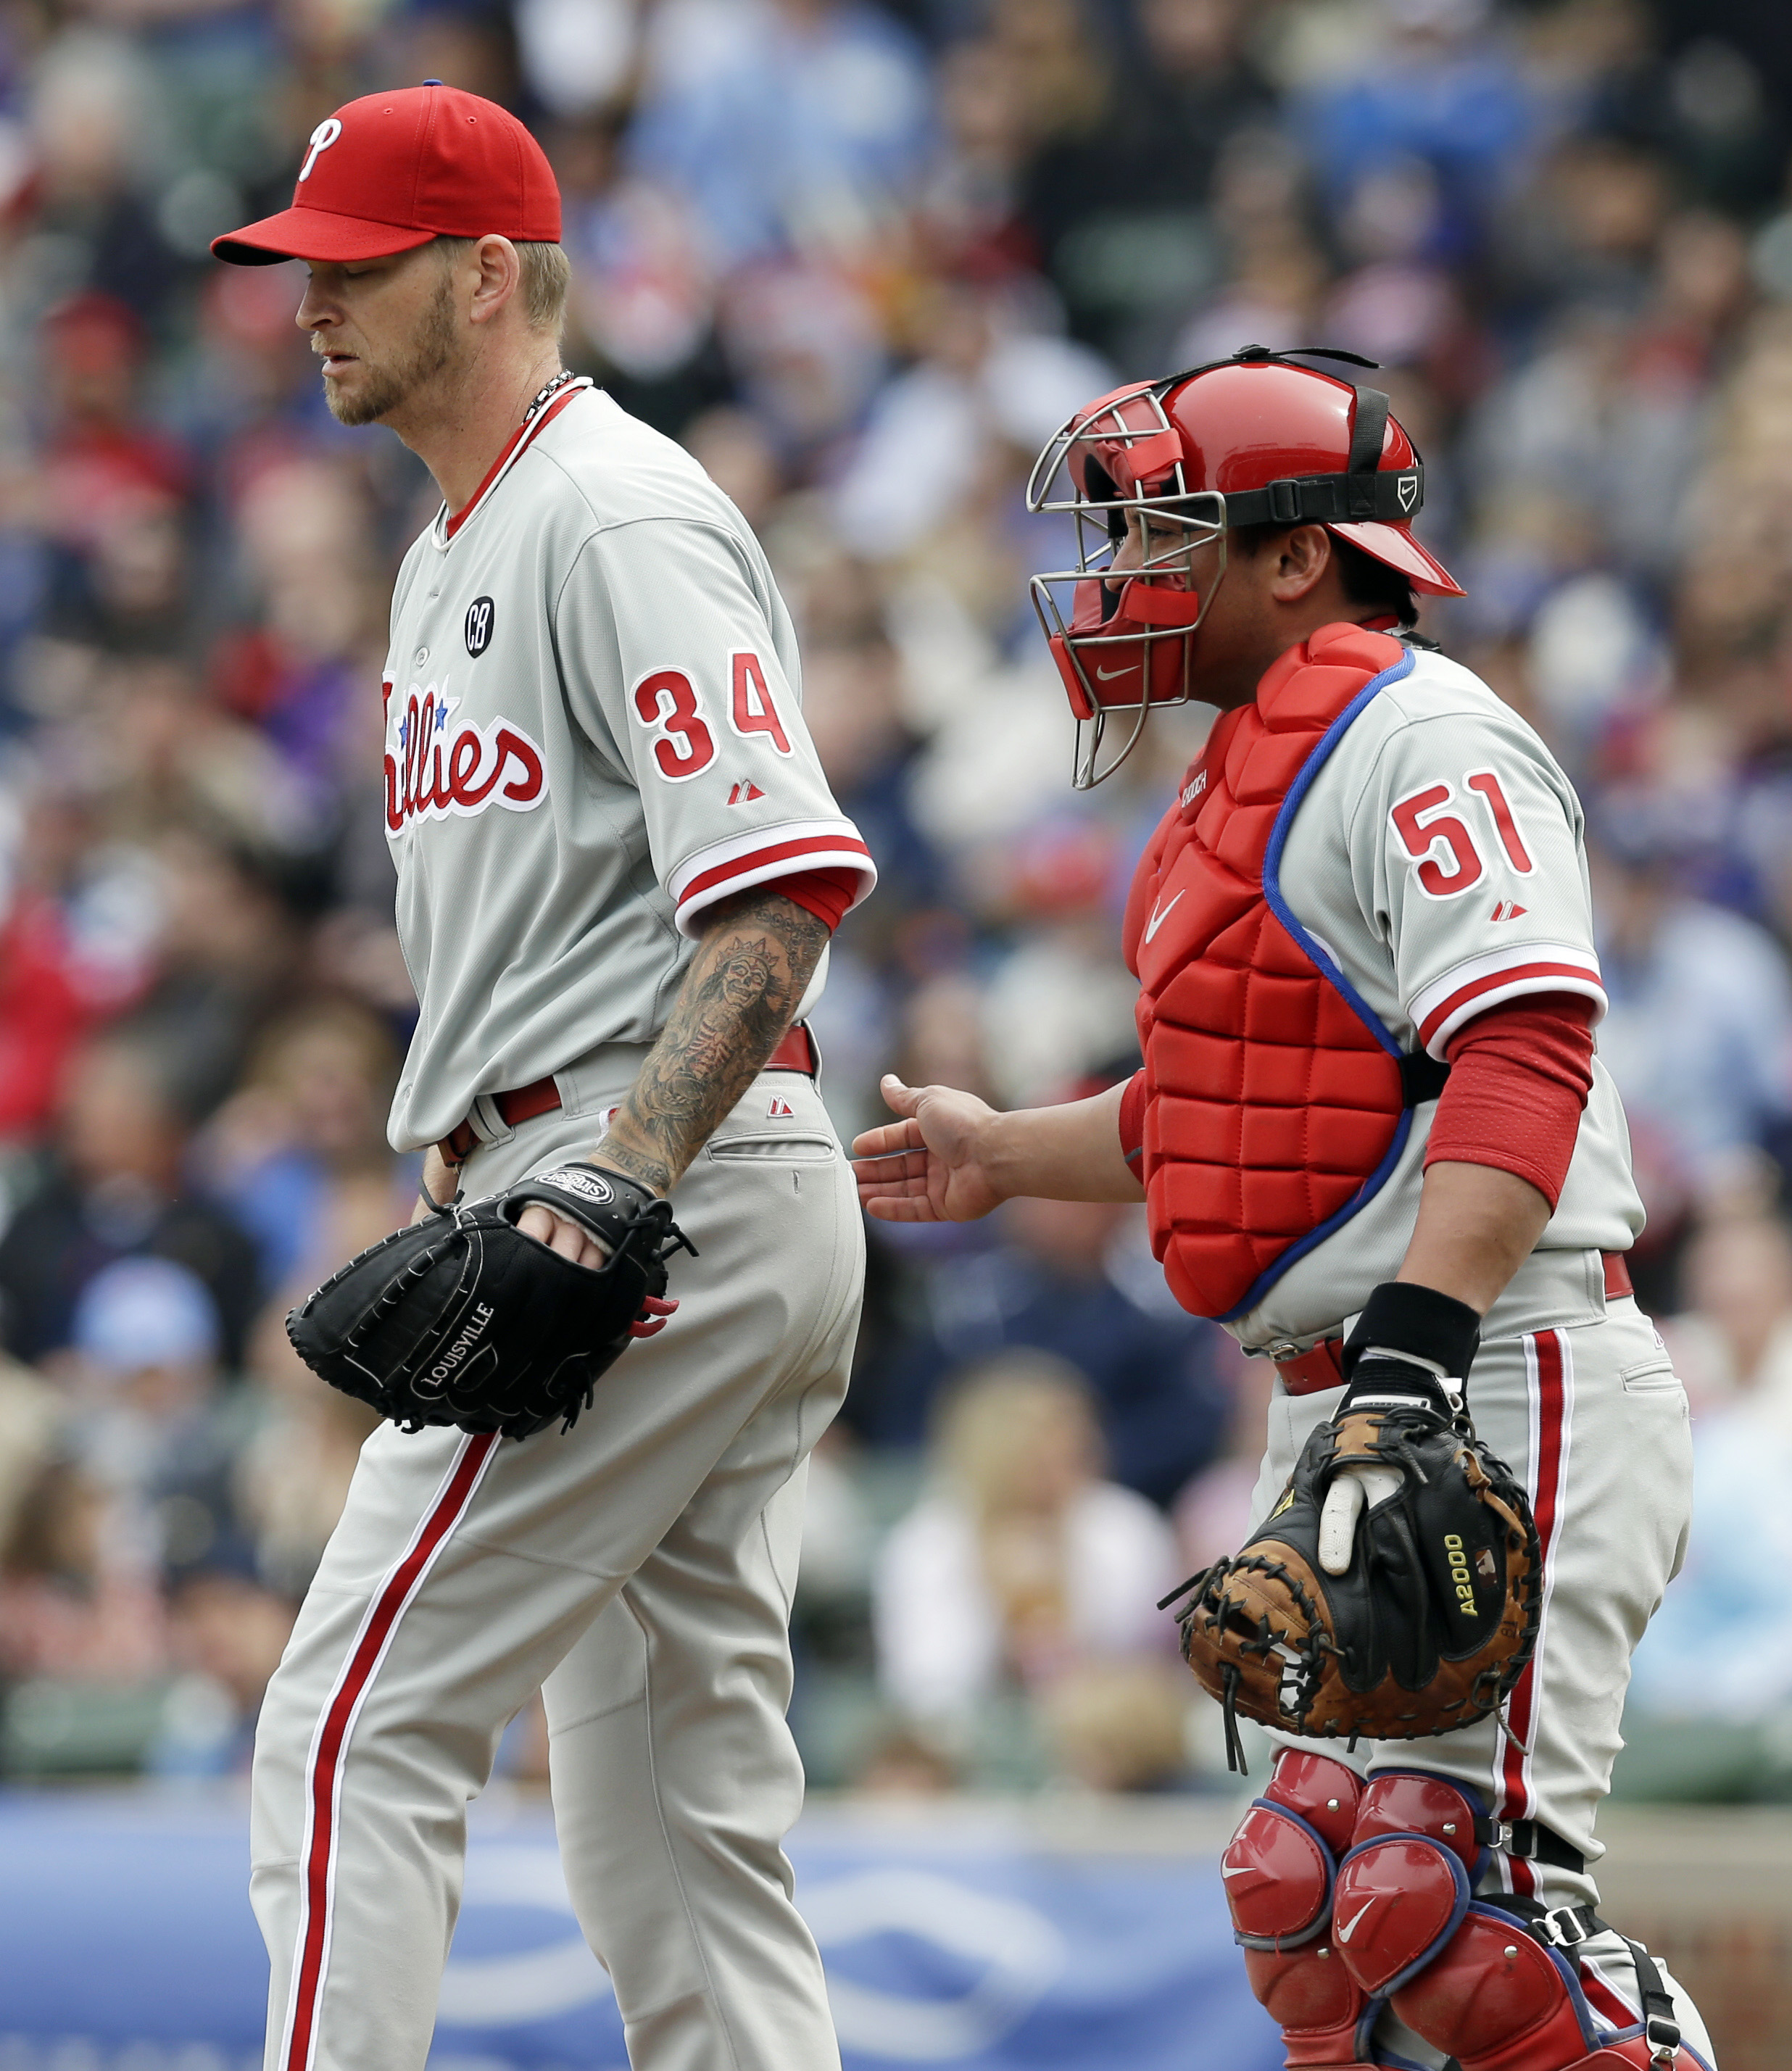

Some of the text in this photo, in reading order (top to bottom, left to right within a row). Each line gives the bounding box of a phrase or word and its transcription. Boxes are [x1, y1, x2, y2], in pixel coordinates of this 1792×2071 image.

[298, 118, 342, 182] P
[468, 602, 491, 651] CB
[630, 649, 795, 783] 34
[1387, 768, 1538, 900] 51
[420, 1302, 494, 1387] LOUISVILLE
[1443, 1534, 1478, 1616] A2000
